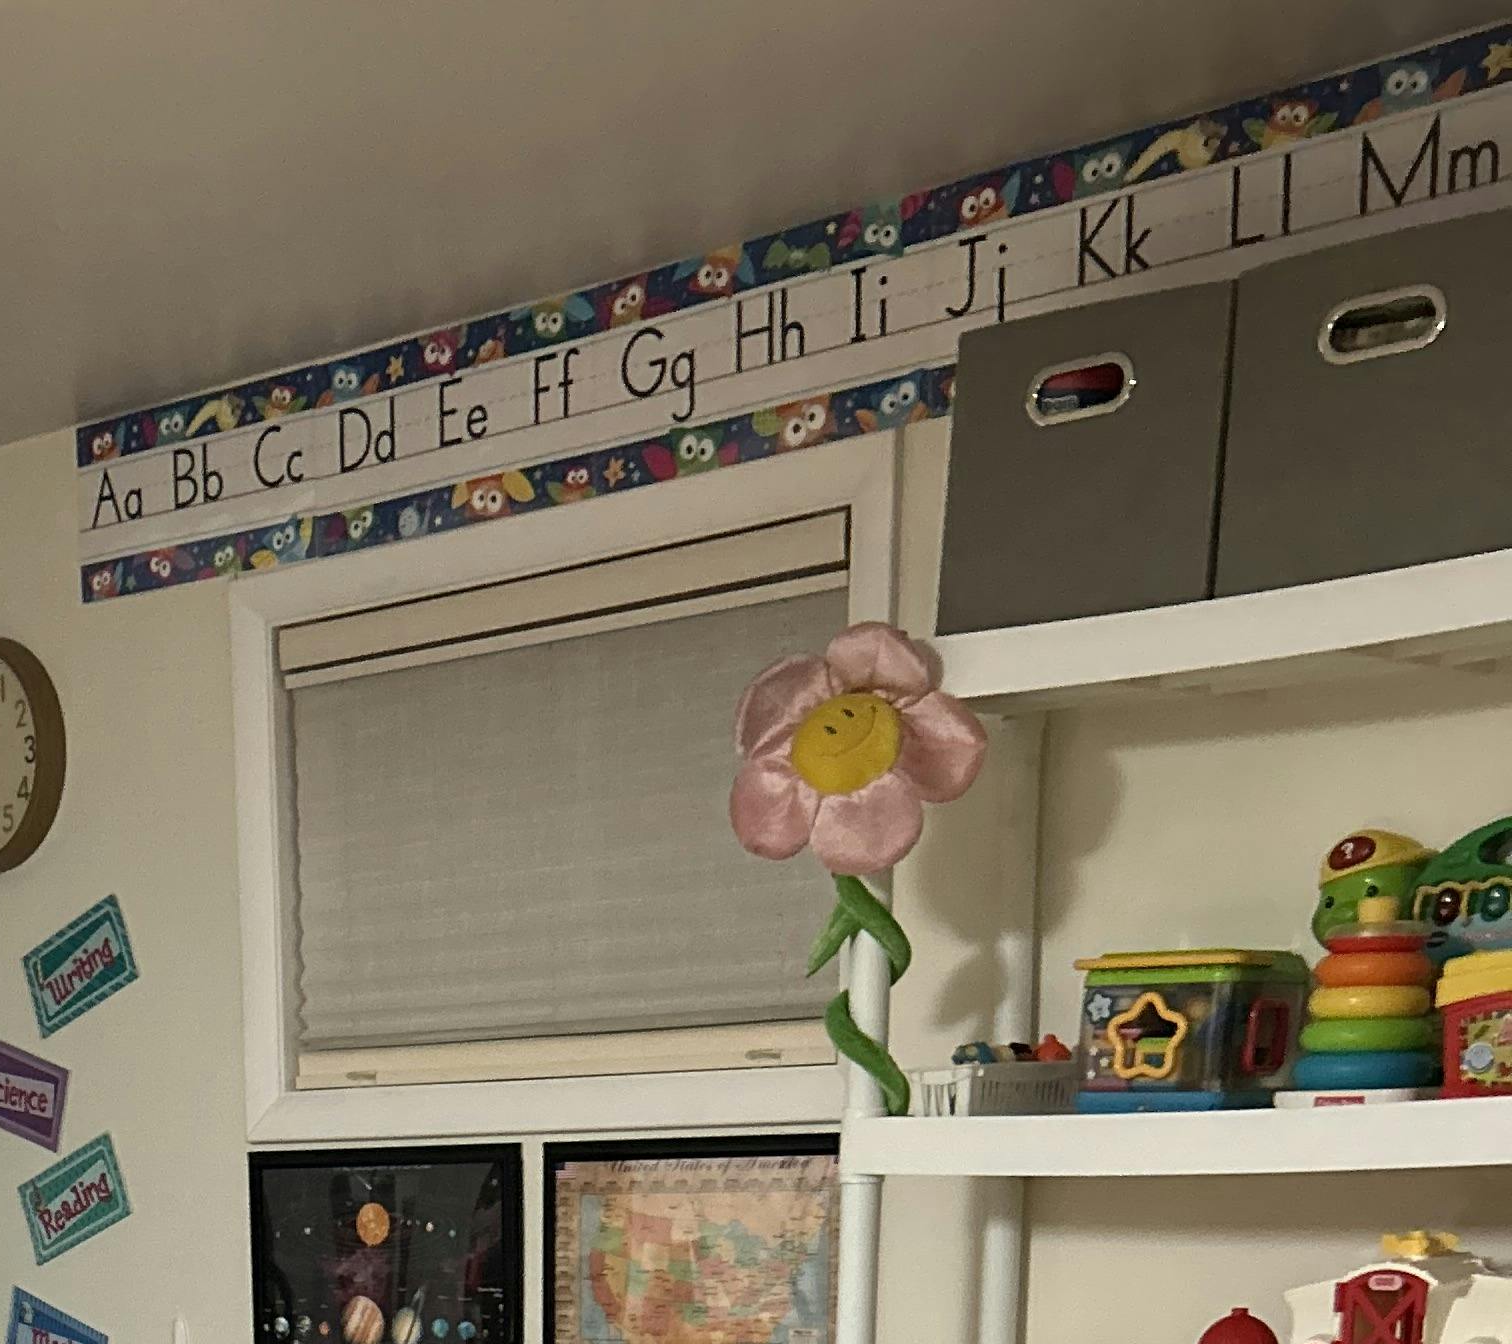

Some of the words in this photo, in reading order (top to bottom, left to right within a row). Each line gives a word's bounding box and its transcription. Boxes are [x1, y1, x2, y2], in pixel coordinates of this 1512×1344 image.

[92, 470, 143, 529] Aa
[173, 449, 224, 510] Bb
[254, 426, 305, 490] Cc
[338, 397, 396, 474] Dd
[437, 377, 488, 449] Ee
[533, 347, 580, 424] Ff
[621, 327, 696, 421] Gg
[735, 289, 805, 374] Hh
[850, 267, 887, 343] Ii
[946, 235, 1008, 322] Jj
[1077, 195, 1151, 286] Kk
[1230, 153, 1293, 248] Ll
[1360, 114, 1499, 216] Mm
[0, 674, 6, 702] 1
[14, 699, 28, 728] 2
[24, 735, 35, 763] 3
[17, 776, 30, 801] 4
[2, 804, 14, 832] 5
[46, 937, 115, 1008] Writing
[38, 1170, 113, 1240] Reading
